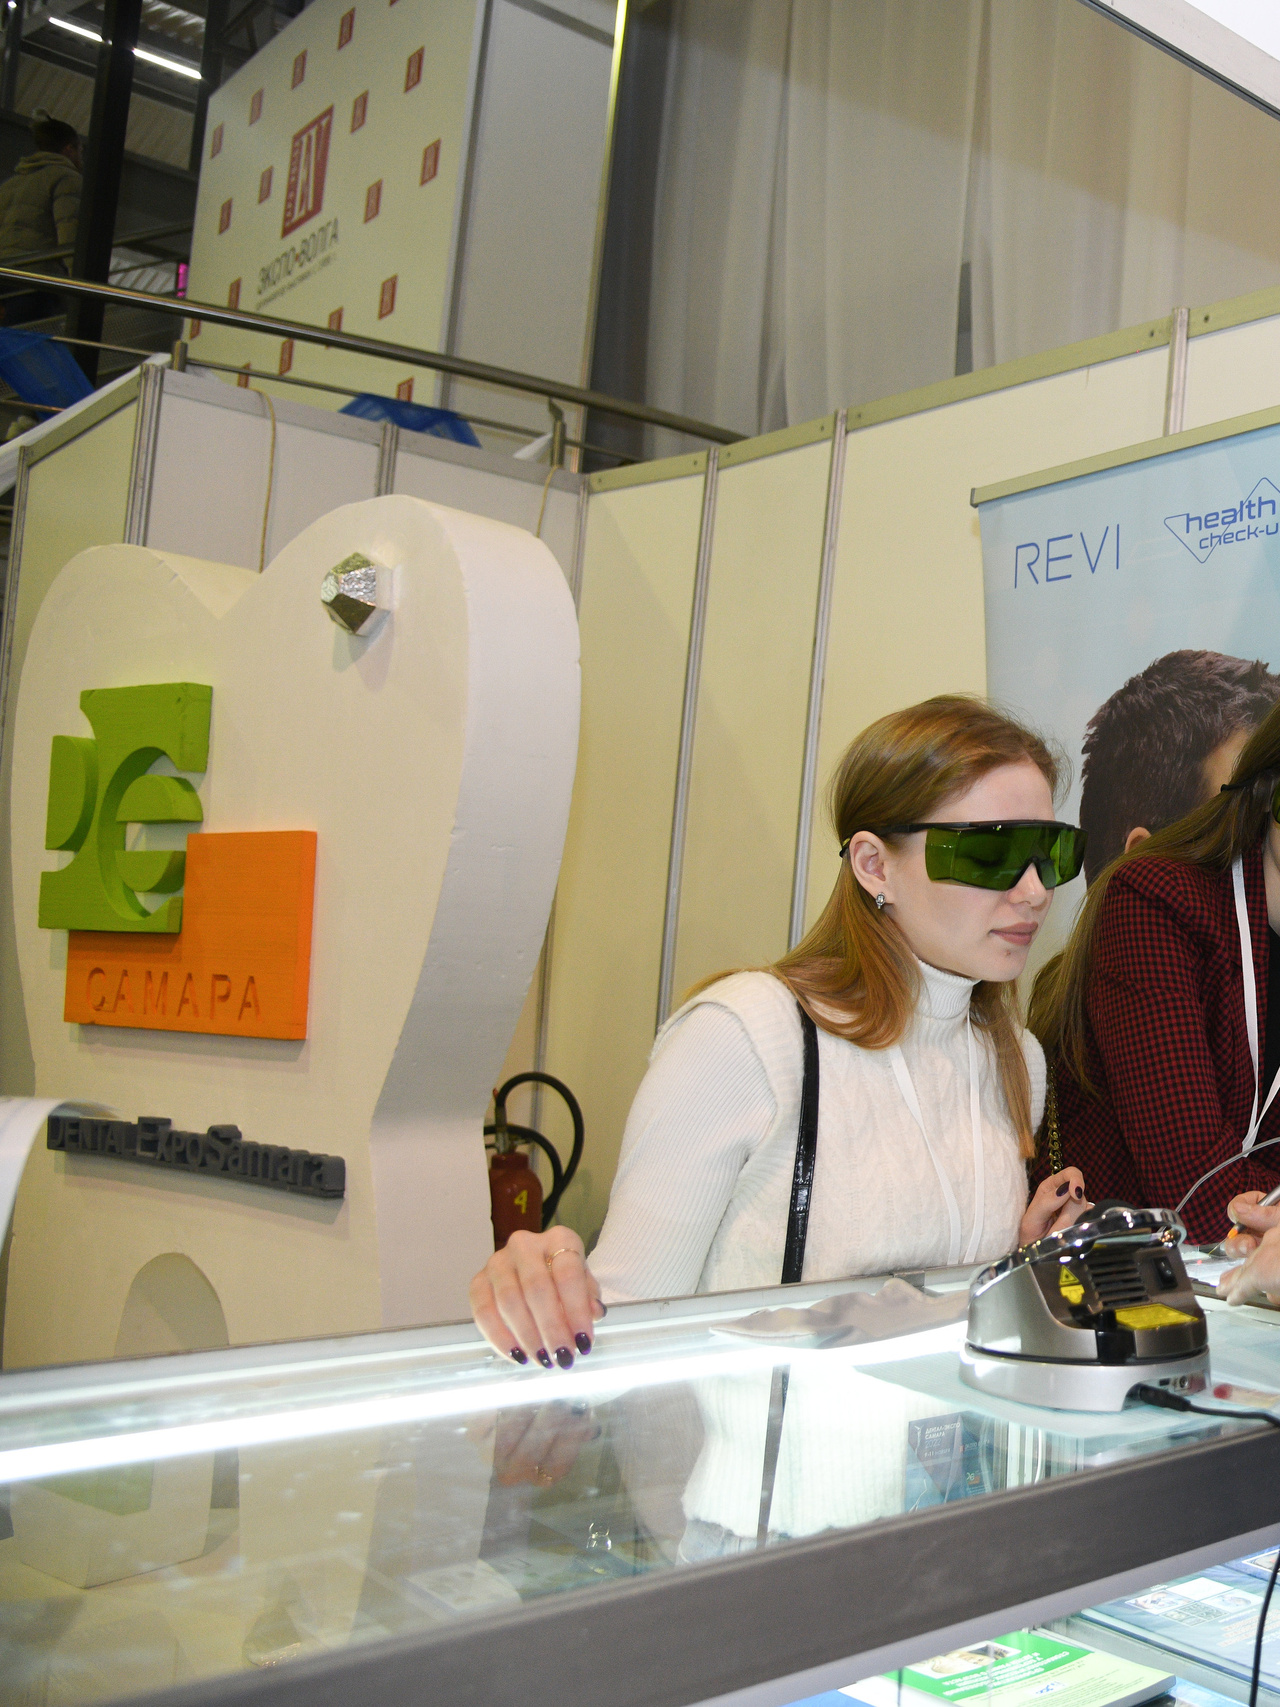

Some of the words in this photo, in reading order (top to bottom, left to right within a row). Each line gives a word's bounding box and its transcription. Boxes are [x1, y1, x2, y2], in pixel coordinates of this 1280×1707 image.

[1185, 496, 1277, 535] health
[1013, 523, 1121, 590] REVI
[85, 966, 262, 1023] САМАРА
[513, 1188, 529, 1215] 4
